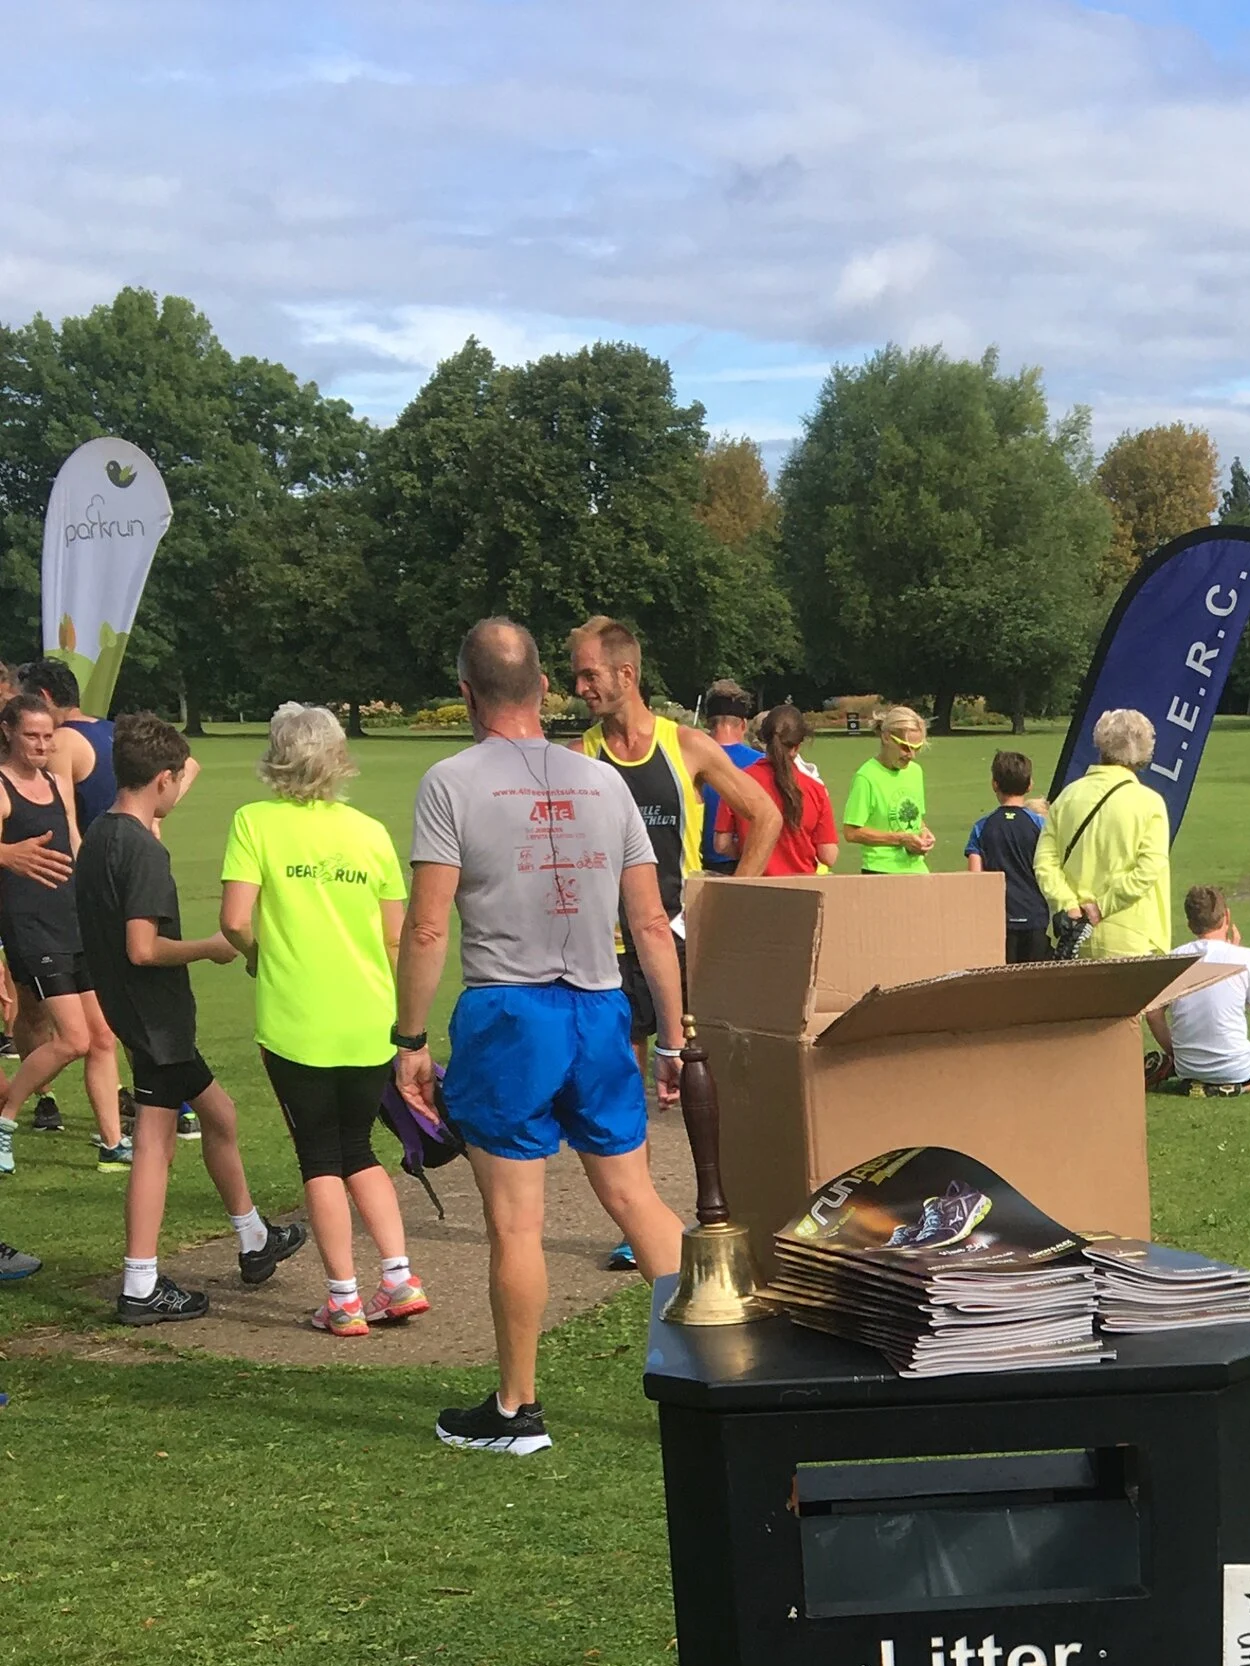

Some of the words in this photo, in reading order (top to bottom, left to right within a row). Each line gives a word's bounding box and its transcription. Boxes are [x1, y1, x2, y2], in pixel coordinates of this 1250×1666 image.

[65, 495, 145, 548] parkrun
[1150, 570, 1248, 782] L.E.R.C.
[335, 868, 367, 885] RUN
